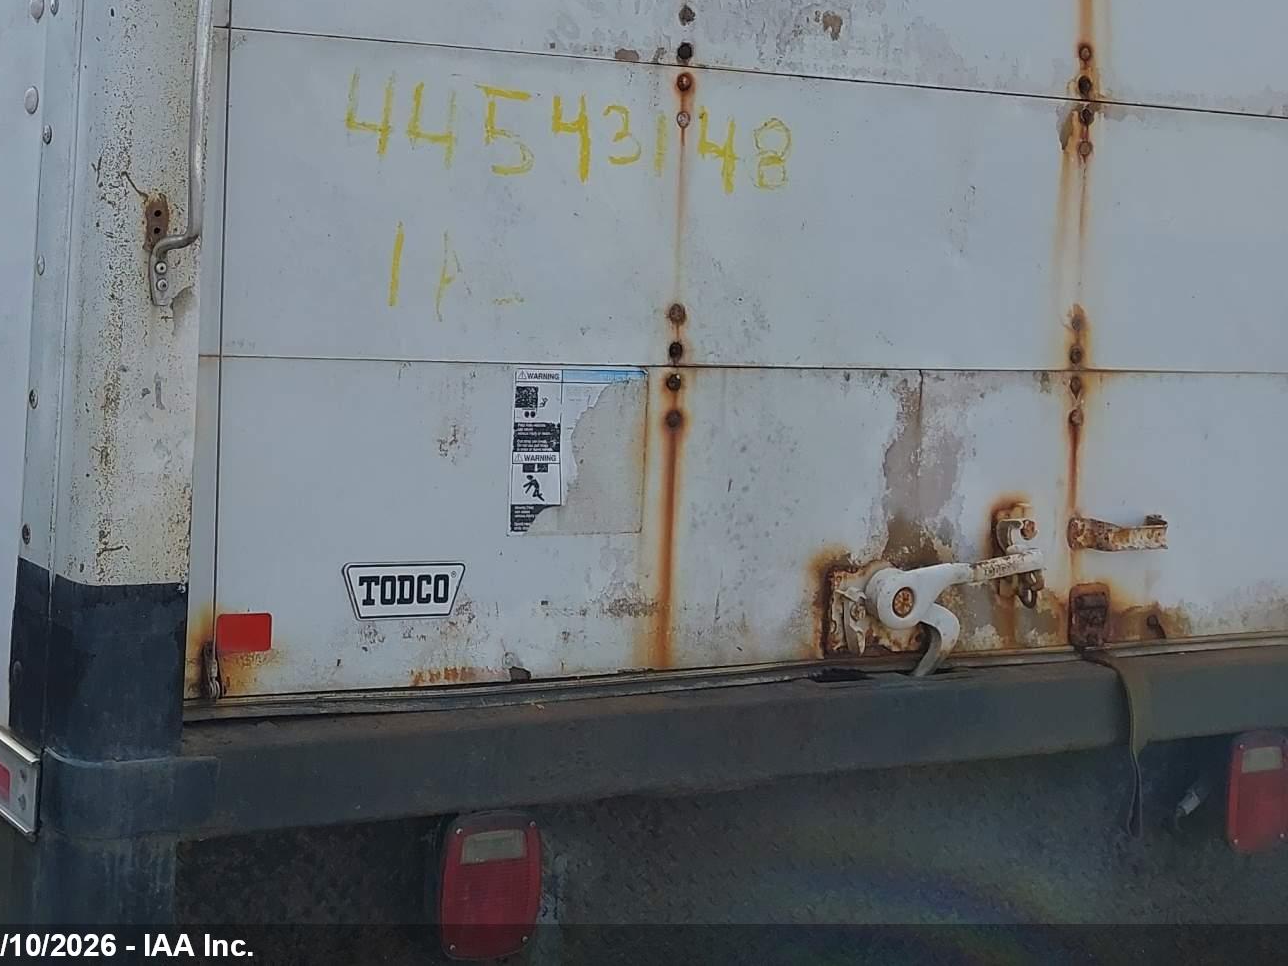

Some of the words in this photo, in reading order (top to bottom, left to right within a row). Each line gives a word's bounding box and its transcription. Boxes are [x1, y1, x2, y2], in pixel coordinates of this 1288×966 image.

[344, 67, 793, 194] 44543148
[527, 371, 560, 381] WARNING
[523, 453, 557, 462] WARNING
[358, 573, 450, 606] TODCO
